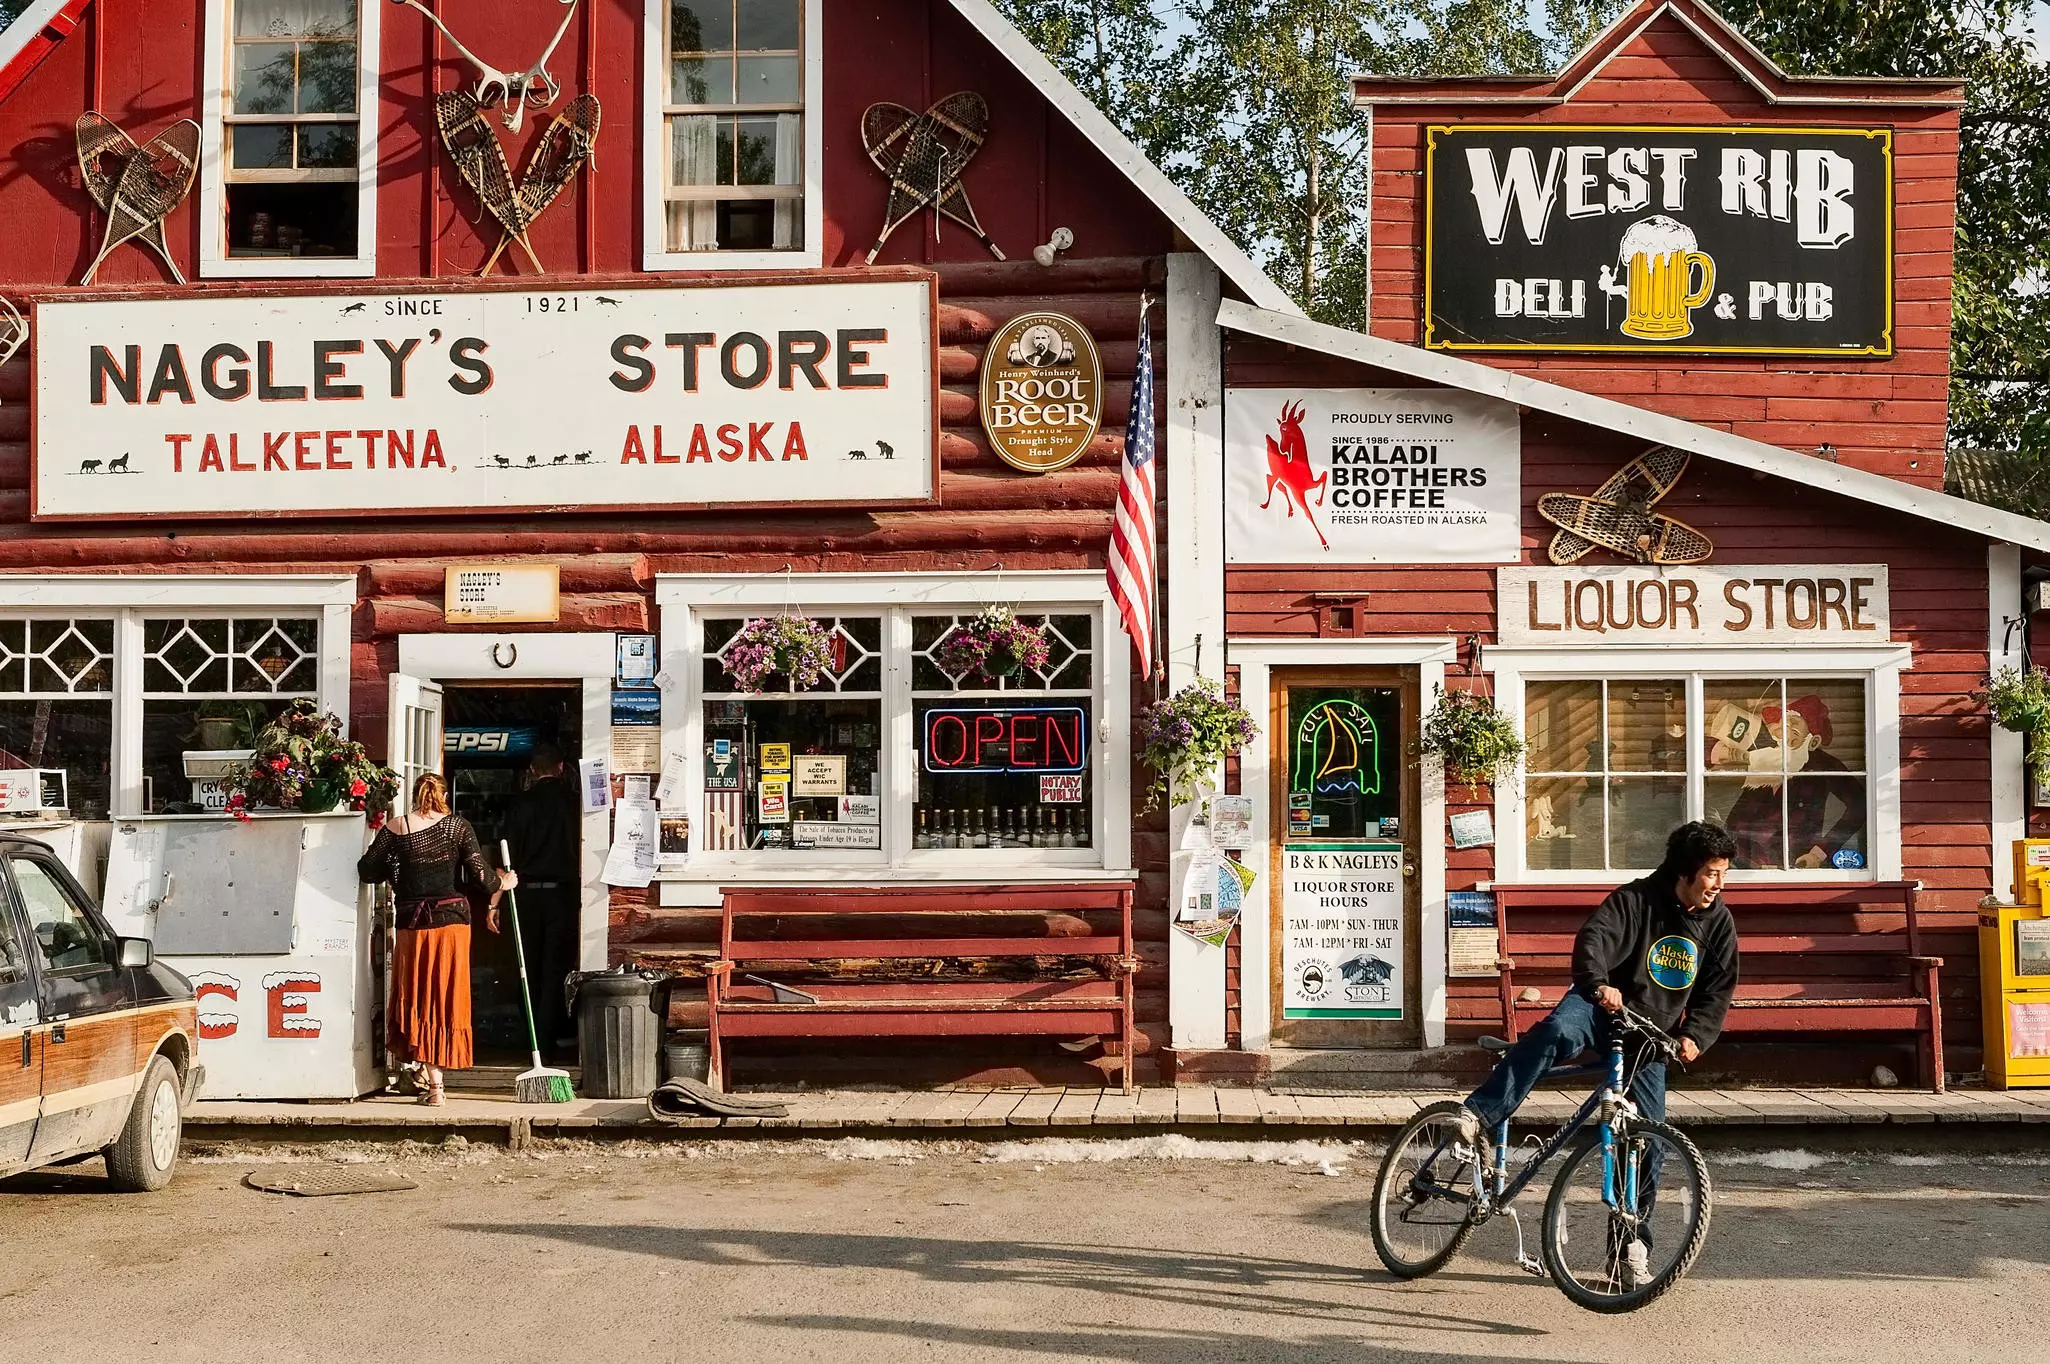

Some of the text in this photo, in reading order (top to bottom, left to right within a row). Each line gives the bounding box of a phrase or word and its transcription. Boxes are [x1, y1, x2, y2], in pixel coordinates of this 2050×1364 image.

[1465, 146, 1855, 249] WEST RIB
[526, 297, 579, 313] 1921
[1495, 278, 1833, 321] DELI & PUB
[90, 327, 888, 406] NAGLEY'S STORE
[1030, 369, 1081, 377] Weinhard's
[1331, 413, 1454, 424] PROUDLY SERVING
[621, 421, 809, 465] ALASKA
[1009, 436, 1073, 446] Draught Style
[1331, 436, 1389, 444] SINCE 1986
[1029, 448, 1053, 456] Head
[1331, 445, 1437, 464] KALADI
[1331, 467, 1487, 487] BROTHERS
[1331, 488, 1445, 508] COFFEE
[1331, 515, 1488, 525] FRESH ROASTED IN ALASKA
[460, 572, 501, 586] NAGLEY'S
[460, 588, 485, 601] STORE
[1528, 578, 1876, 634] LIQUOR STORE
[444, 733, 509, 751] EPSI
[932, 716, 1078, 766] OPEN
[201, 781, 221, 793] CRY
[707, 778, 737, 787] THE USA
[1041, 776, 1081, 788] NOTARY
[1041, 788, 1081, 801] PUBLIC
[763, 802, 783, 810] Card
[835, 836, 844, 844] Age
[1290, 855, 1398, 869] B & K NAGLEYS
[1294, 882, 1395, 894] LIQUOR STORE
[1320, 897, 1368, 907] HOURS
[1289, 919, 1308, 930] 7AM
[1316, 919, 1339, 930] 10PM
[1347, 919, 1366, 930] SUN
[1372, 919, 1399, 930] THUR
[1293, 938, 1313, 949] 7AM
[1321, 938, 1345, 949] 12PM
[1353, 938, 1368, 949] FRI
[1375, 938, 1392, 949] SAT
[1658, 944, 1695, 962] Alaska
[1294, 958, 1333, 973] DESCHUTES
[1652, 953, 1696, 973] GROWN
[1296, 990, 1330, 1001] BREWERY
[1344, 986, 1390, 1001] STONE
[187, 971, 321, 1039] CE
